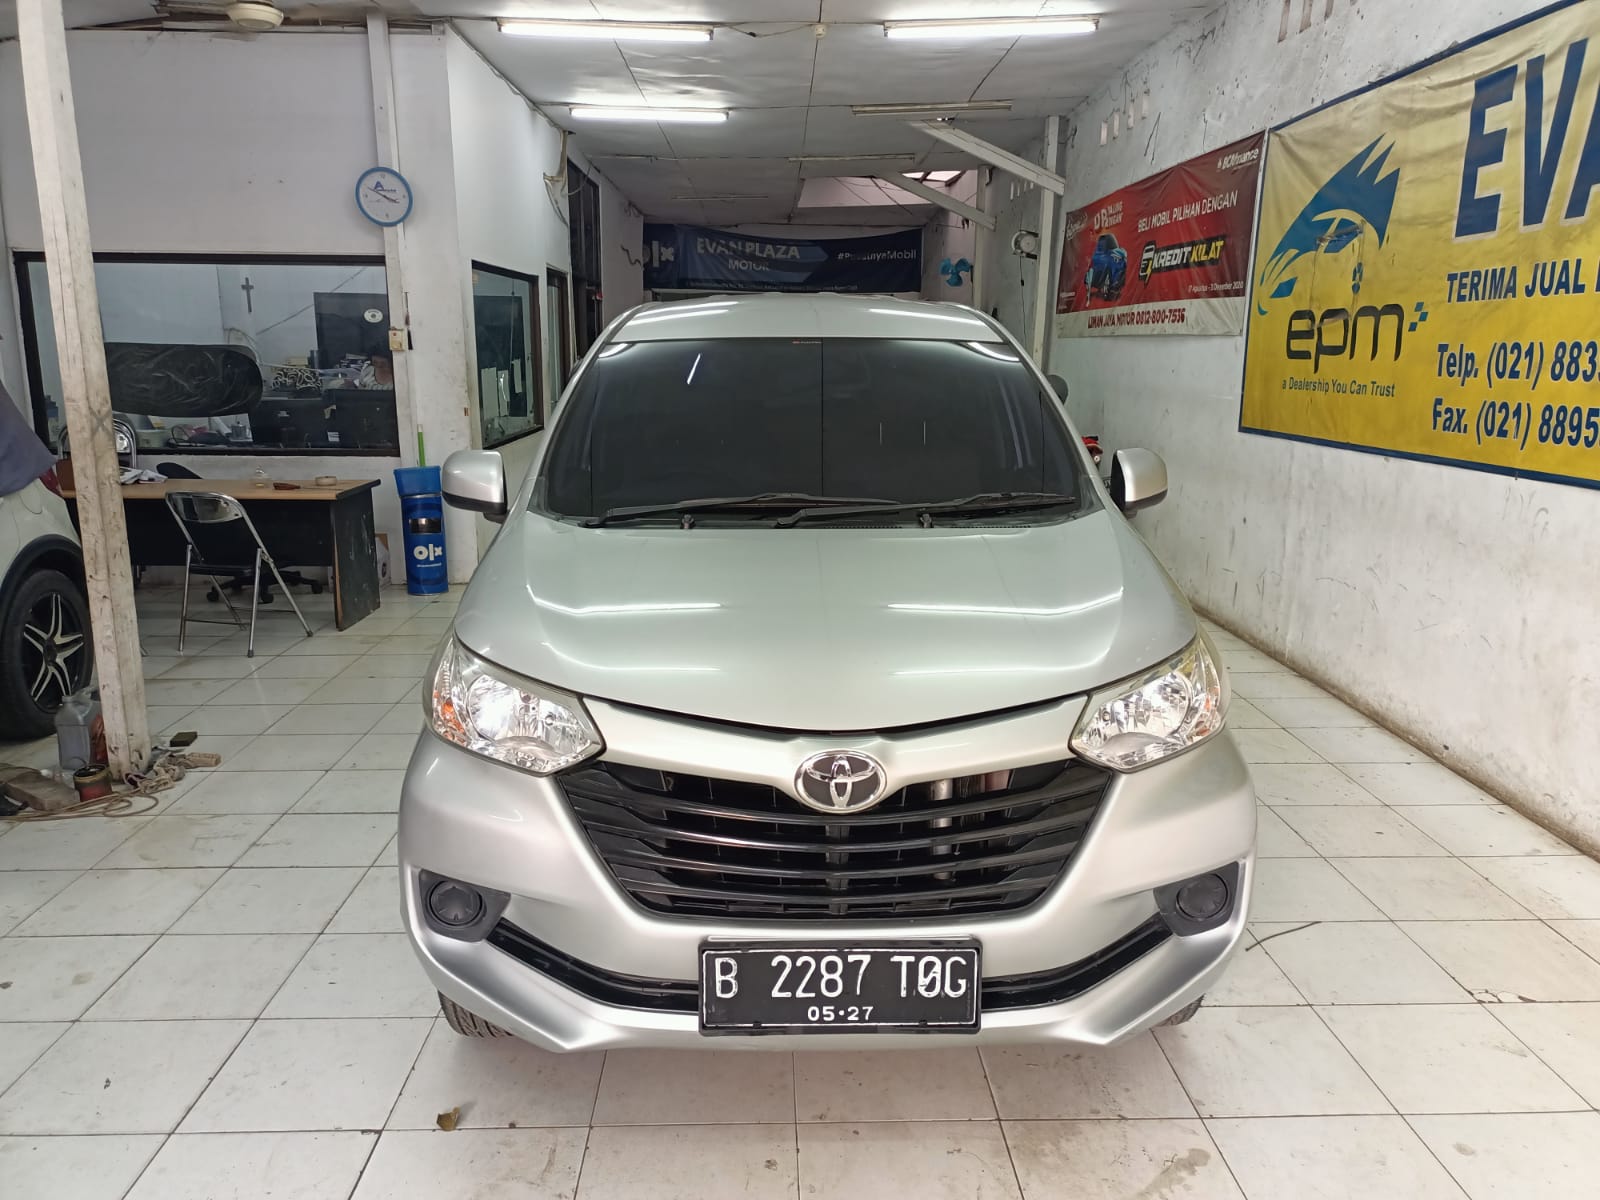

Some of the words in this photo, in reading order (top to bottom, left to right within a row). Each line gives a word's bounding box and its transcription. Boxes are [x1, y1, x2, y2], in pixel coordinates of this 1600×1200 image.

[1137, 215, 1151, 232] BELI
[1151, 209, 1170, 229] MOBIL
[1171, 201, 1201, 222] PILIHAN
[1201, 190, 1238, 215] DENGAN
[745, 241, 801, 259] PLAZA
[1152, 246, 1192, 269] KREDIT
[1190, 240, 1225, 262] KILAT
[1447, 266, 1517, 303] TERIMA
[1525, 258, 1586, 298] JUAL
[1286, 303, 1405, 374] epm
[1437, 343, 1479, 387] Telp.
[1487, 341, 1544, 390] (021)
[1550, 341, 1600, 383] 883
[1282, 379, 1287, 390] a
[1289, 376, 1329, 395] Dealership
[1331, 379, 1347, 394] You
[1349, 380, 1367, 396] Can
[1371, 380, 1395, 398] Trust
[1432, 398, 1468, 433] Fax.
[1476, 401, 1532, 450] (021)
[1538, 404, 1600, 448] 8895
[413, 543, 443, 561] olx
[714, 957, 738, 998] B
[770, 955, 871, 998] 2287
